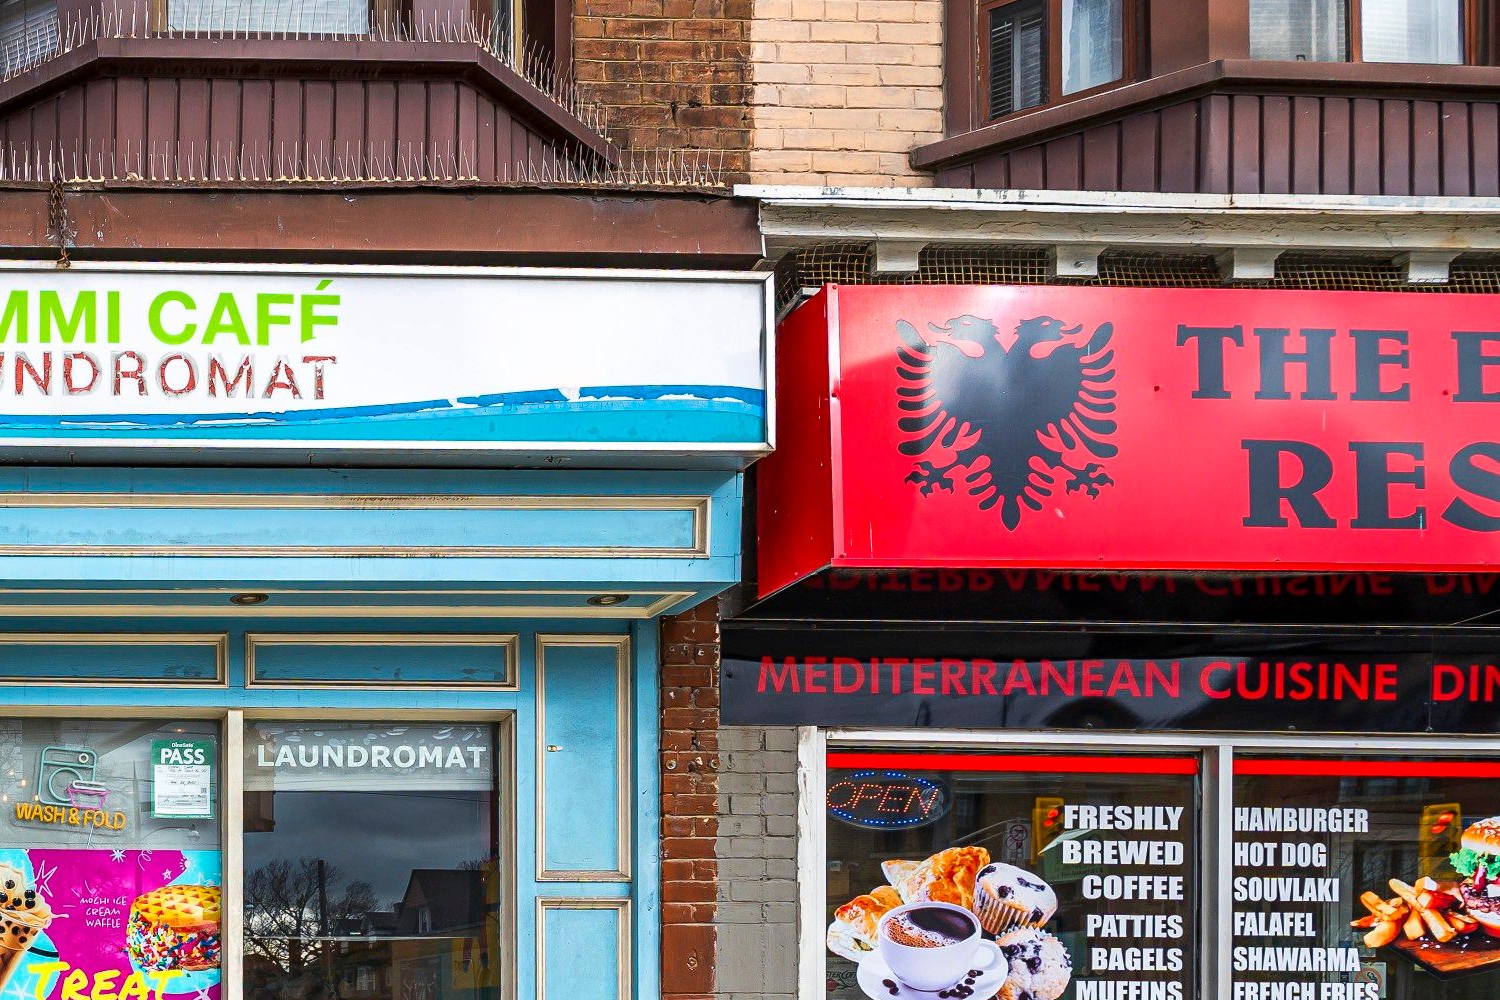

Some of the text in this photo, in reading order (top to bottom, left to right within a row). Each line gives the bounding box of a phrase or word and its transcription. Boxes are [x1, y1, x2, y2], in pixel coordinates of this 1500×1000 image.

[148, 279, 341, 346] CAFÉ
[1176, 323, 1411, 401] THE
[1241, 439, 1500, 533] RES
[756, 655, 1182, 698] MEDITERRANEAN
[1199, 661, 1399, 701] CUISINE
[160, 747, 205, 765] PASS
[257, 744, 487, 768] LAUNDROMAT
[826, 781, 940, 814] OPEN
[15, 802, 127, 831] WASH & FOLD
[1064, 805, 1185, 831] FRESHLY
[1233, 807, 1369, 833] HAMBURGER
[1062, 840, 1184, 866] BREWED
[1234, 842, 1327, 868] HOT DOG
[80, 896, 127, 906] MOCHI ICE
[1081, 875, 1184, 901] COFFEE
[1233, 877, 1340, 903] SOUVLAKI
[85, 918, 121, 929] WAFFLE
[86, 907, 121, 917] CREAM
[1233, 912, 1316, 937] FALAFEL
[1086, 914, 1184, 939] PATTIES
[1091, 947, 1184, 972] BAGELS
[1233, 946, 1361, 972] SHAWARMA
